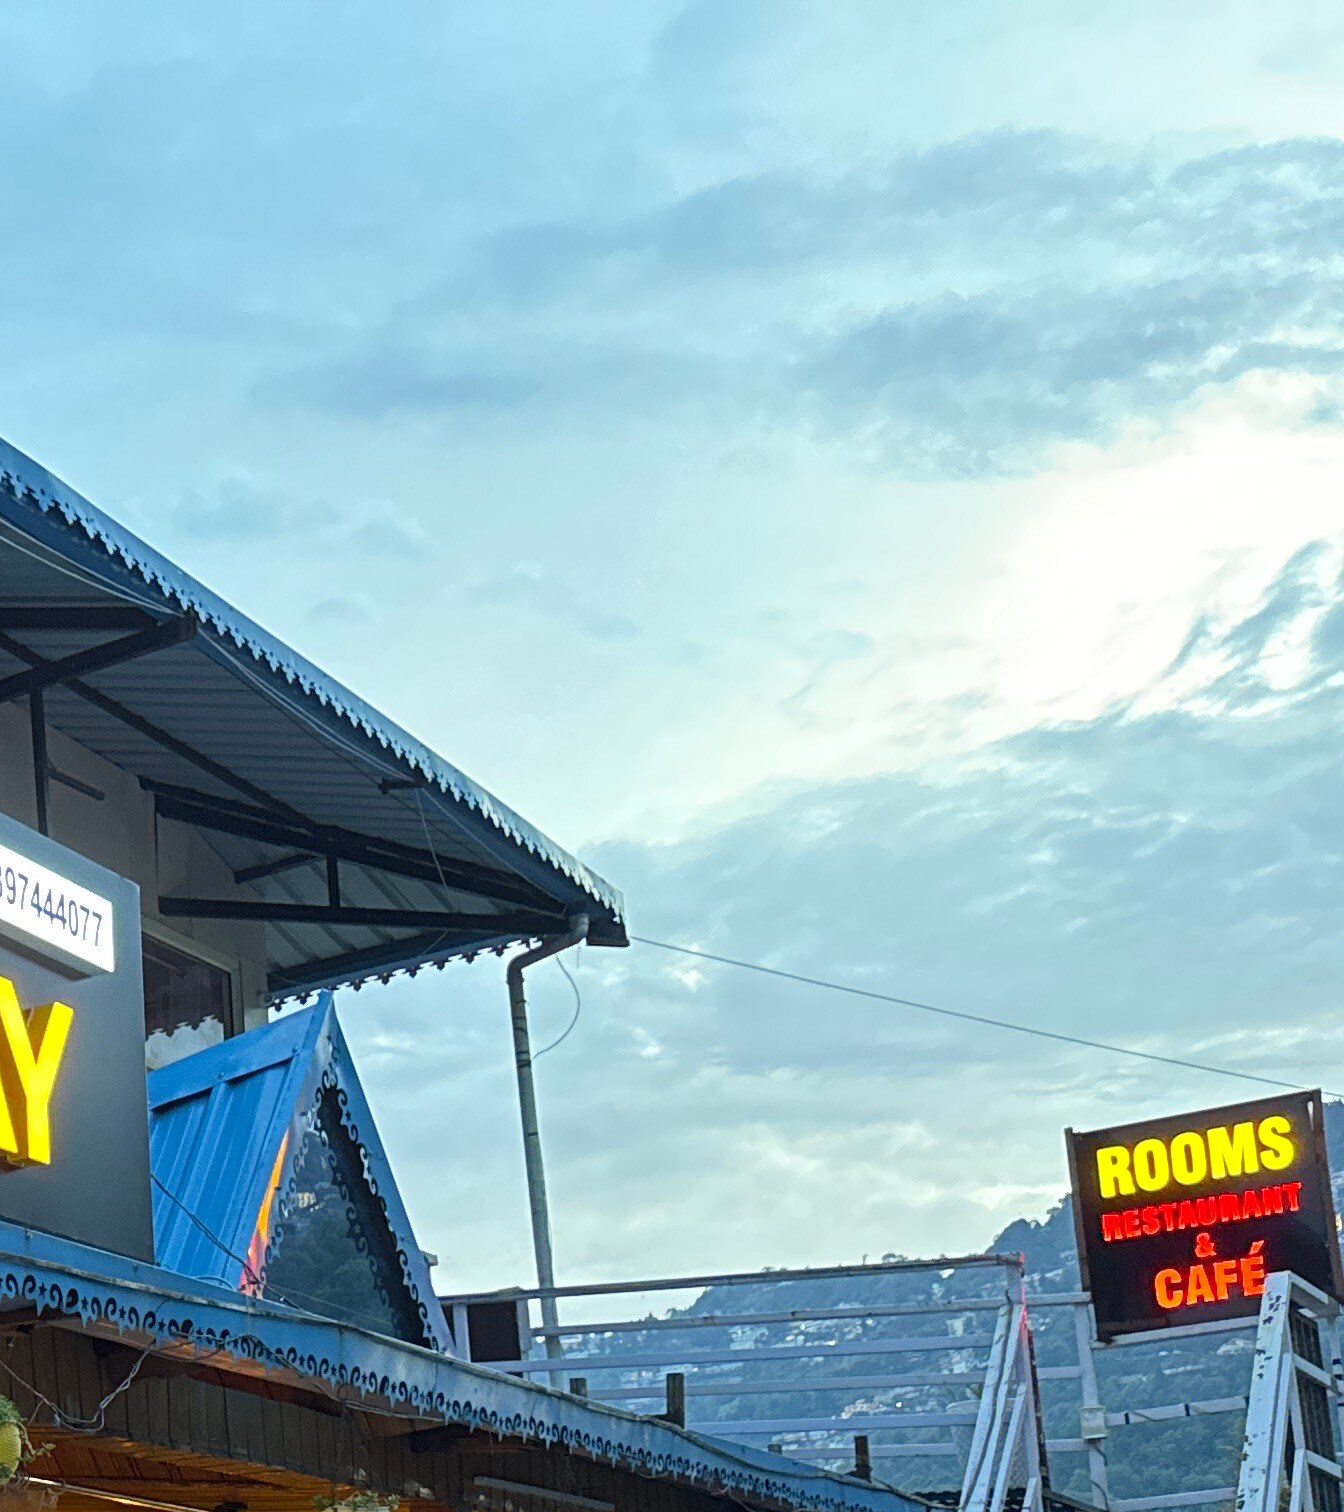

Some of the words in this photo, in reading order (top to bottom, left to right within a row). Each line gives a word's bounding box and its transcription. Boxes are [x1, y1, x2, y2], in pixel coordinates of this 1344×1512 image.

[1096, 1115, 1295, 1198] ROOMS
[1101, 1182, 1302, 1241] RESTAURANT
[1154, 1241, 1266, 1309] CAFÉ
[1194, 1232, 1216, 1258] &
